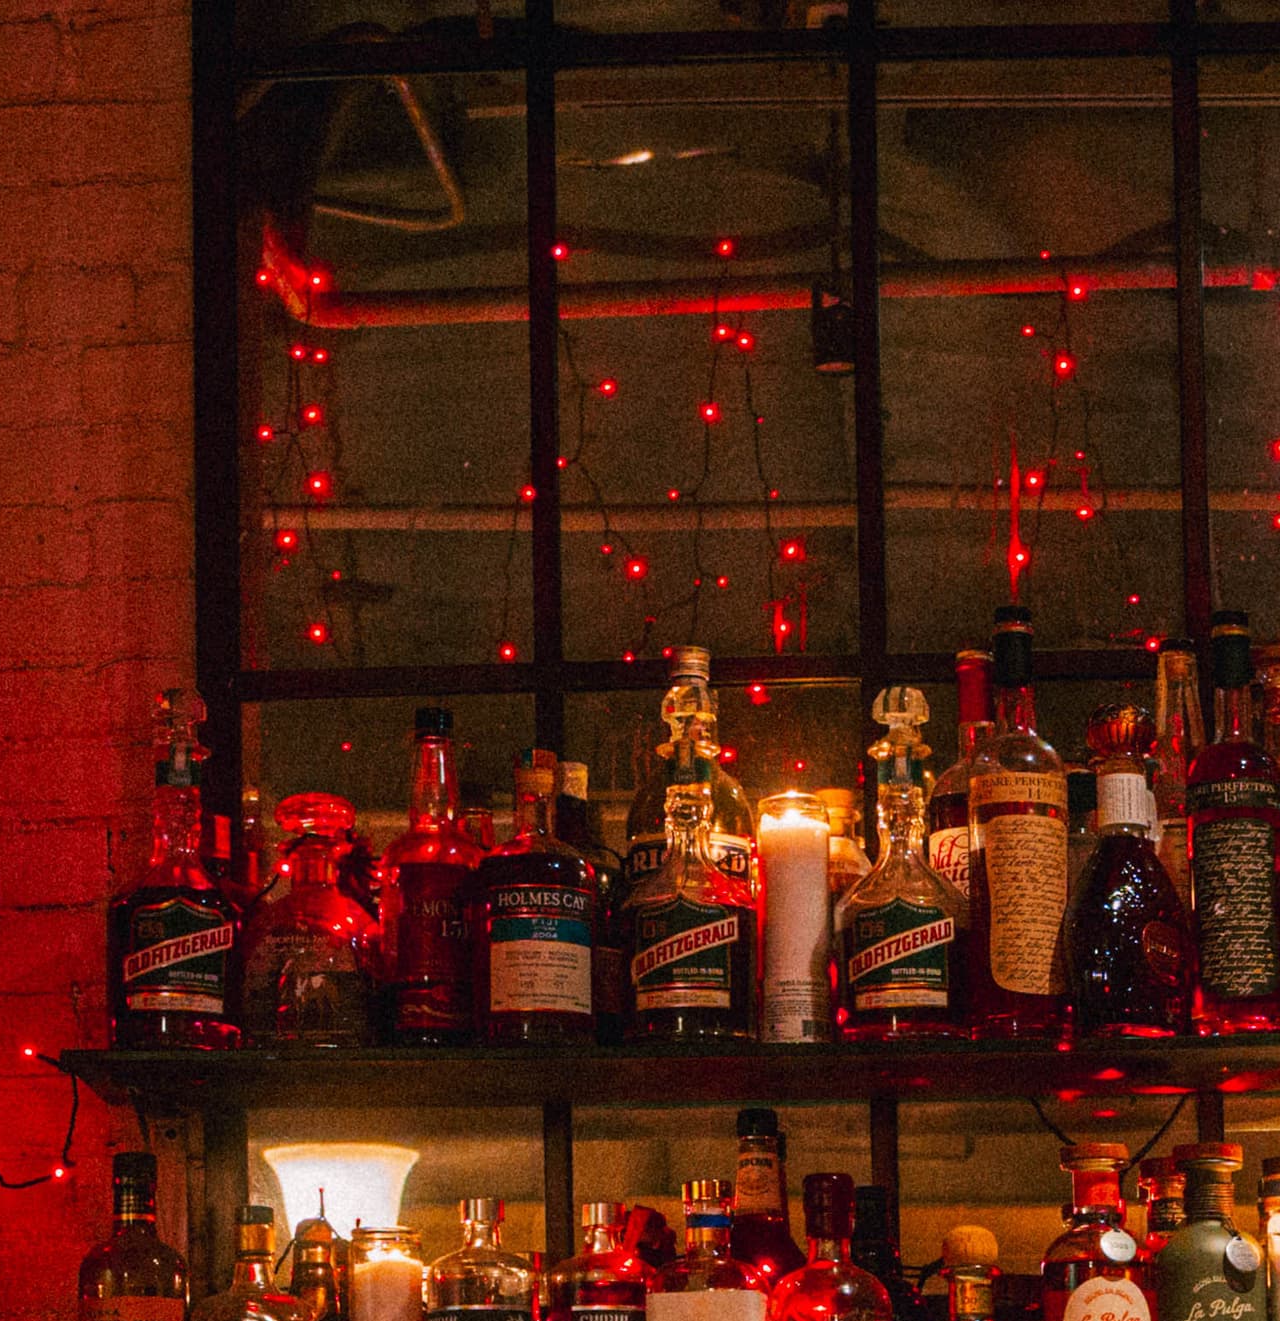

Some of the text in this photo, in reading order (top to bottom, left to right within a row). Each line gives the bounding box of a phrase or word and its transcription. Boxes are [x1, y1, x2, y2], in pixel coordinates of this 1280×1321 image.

[1211, 783, 1275, 794] PERFECTION
[498, 892, 586, 910] HOLMES CAY
[127, 927, 232, 976] OLD FITZGERALD
[635, 920, 735, 977] OLD FITZGERALD
[852, 921, 952, 974] OLD FITZGERALD
[1209, 1297, 1253, 1320] Pulga
